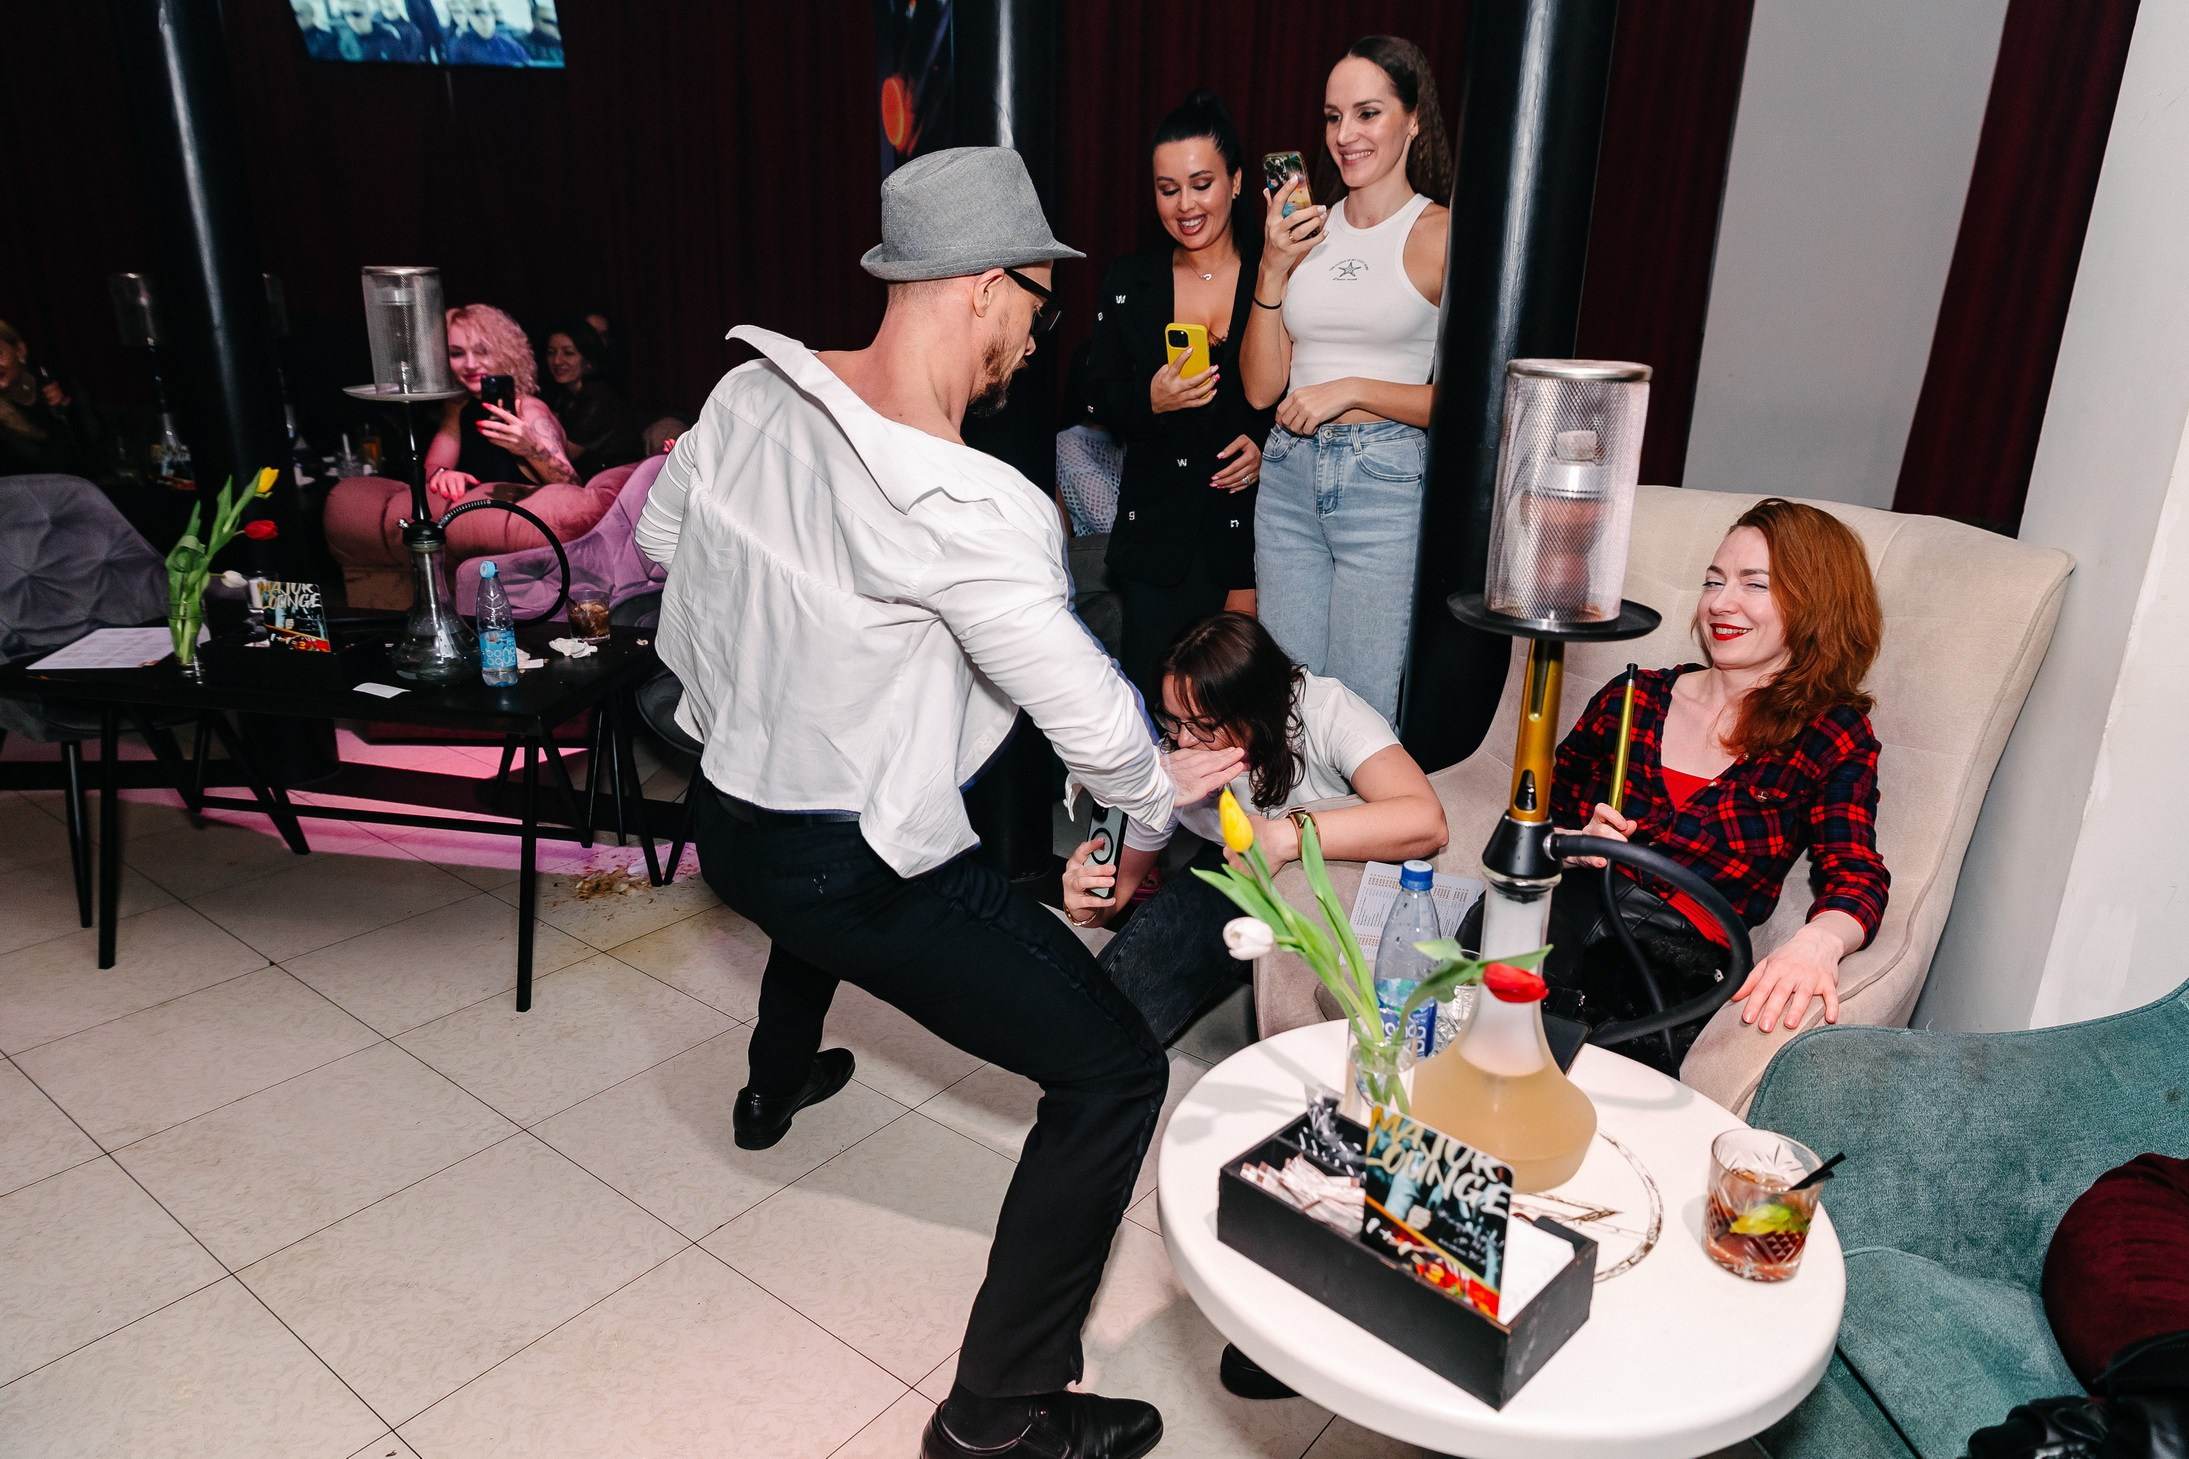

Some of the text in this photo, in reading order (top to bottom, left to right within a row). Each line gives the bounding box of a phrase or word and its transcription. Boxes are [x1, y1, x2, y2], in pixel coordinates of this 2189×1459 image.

[260, 591, 322, 610] LOUNGE
[1365, 1135, 1513, 1220] LOUNGE
[1370, 1104, 1499, 1183] MAJOR
